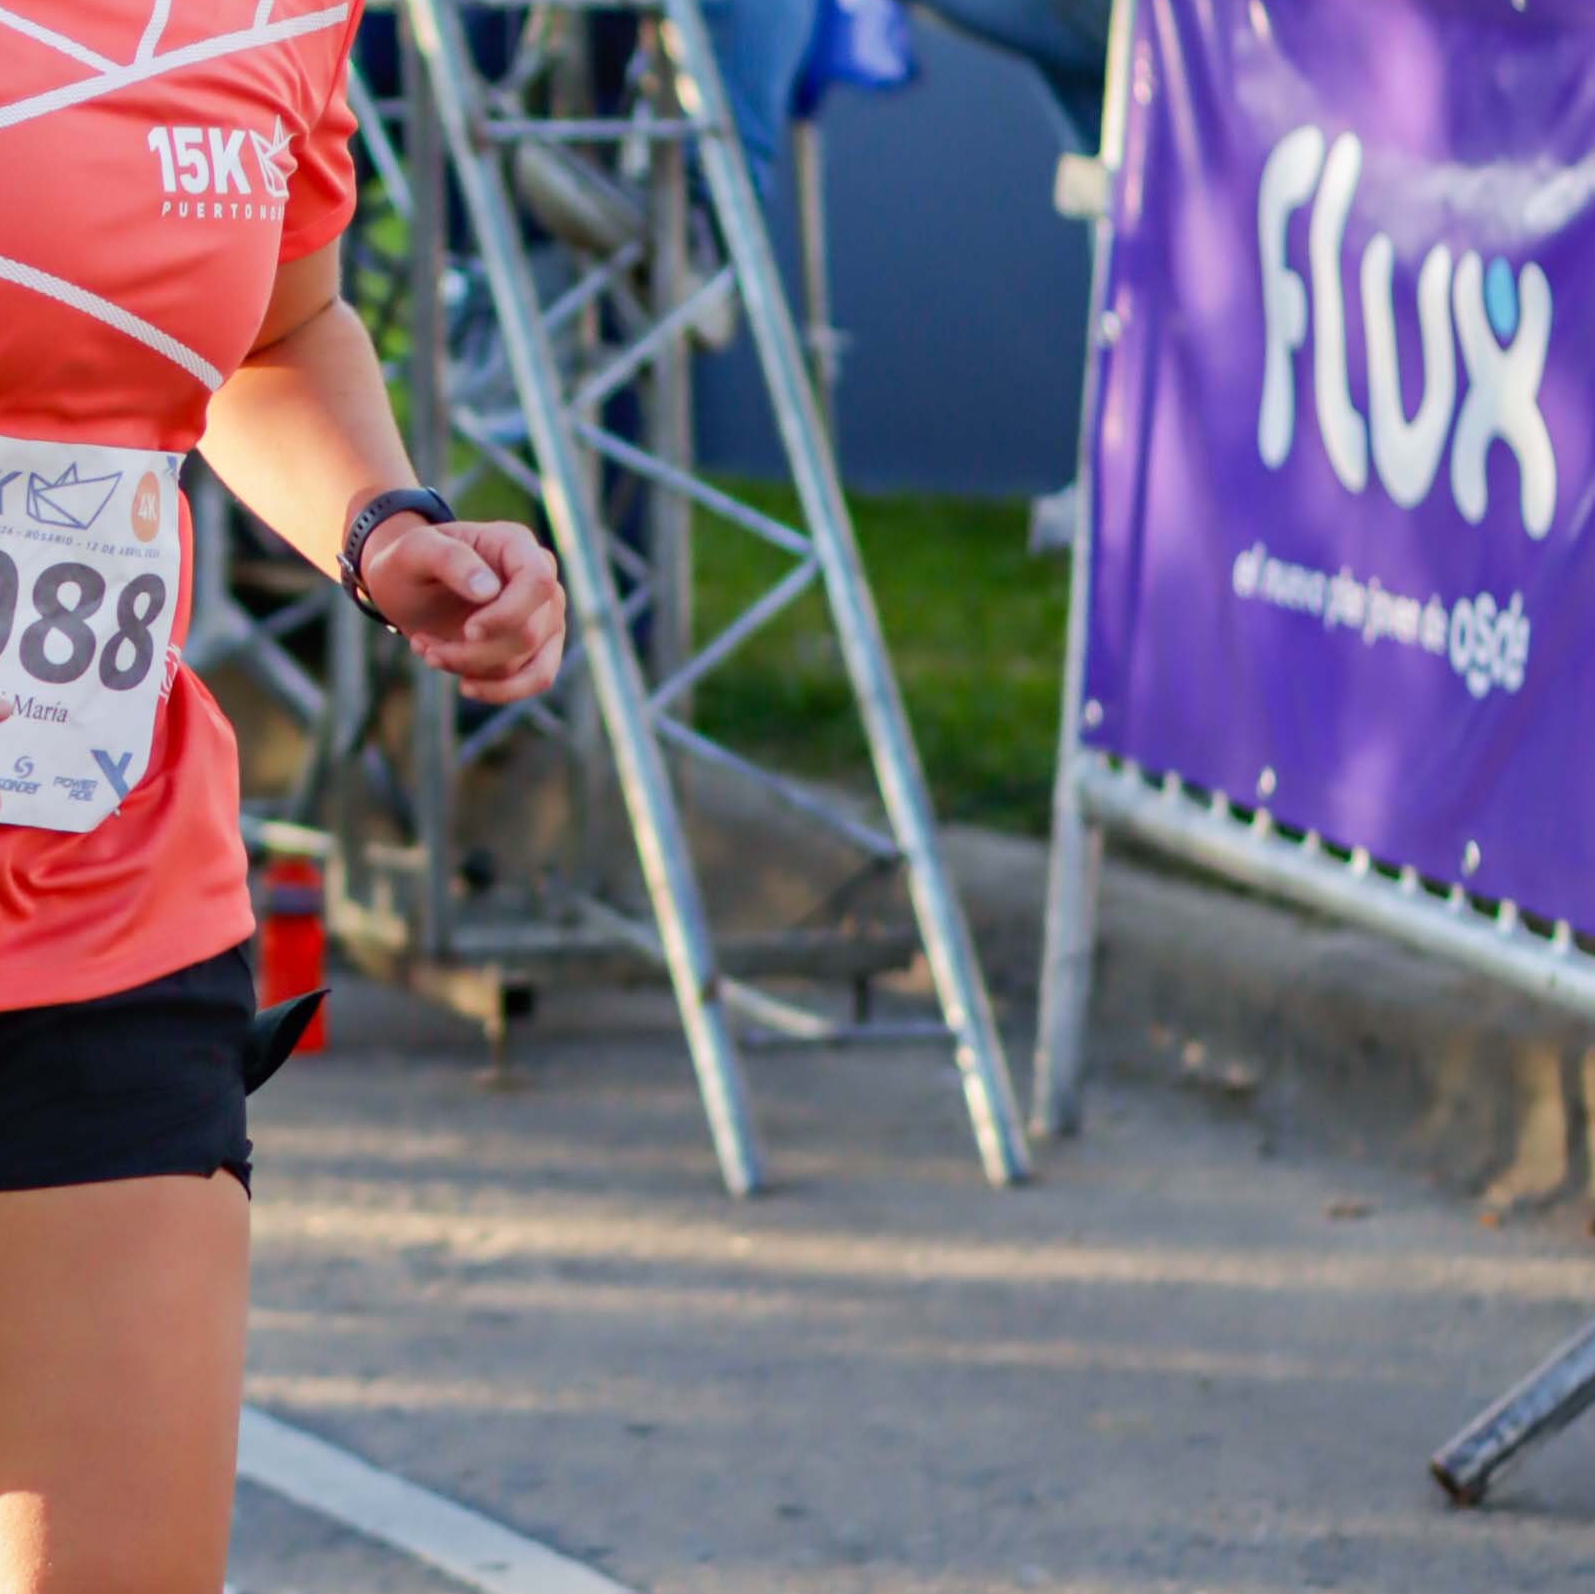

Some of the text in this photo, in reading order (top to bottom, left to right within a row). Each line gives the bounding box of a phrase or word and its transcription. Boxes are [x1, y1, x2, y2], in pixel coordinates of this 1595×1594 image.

[147, 125, 252, 195] 15K
[161, 201, 254, 221] PUERTO
[137, 493, 157, 522] 4K
[24, 529, 74, 546] ROSARIO
[101, 544, 115, 556] DE
[1232, 540, 1531, 699] el nuevo plan joven de osde
[12, 694, 69, 723] María
